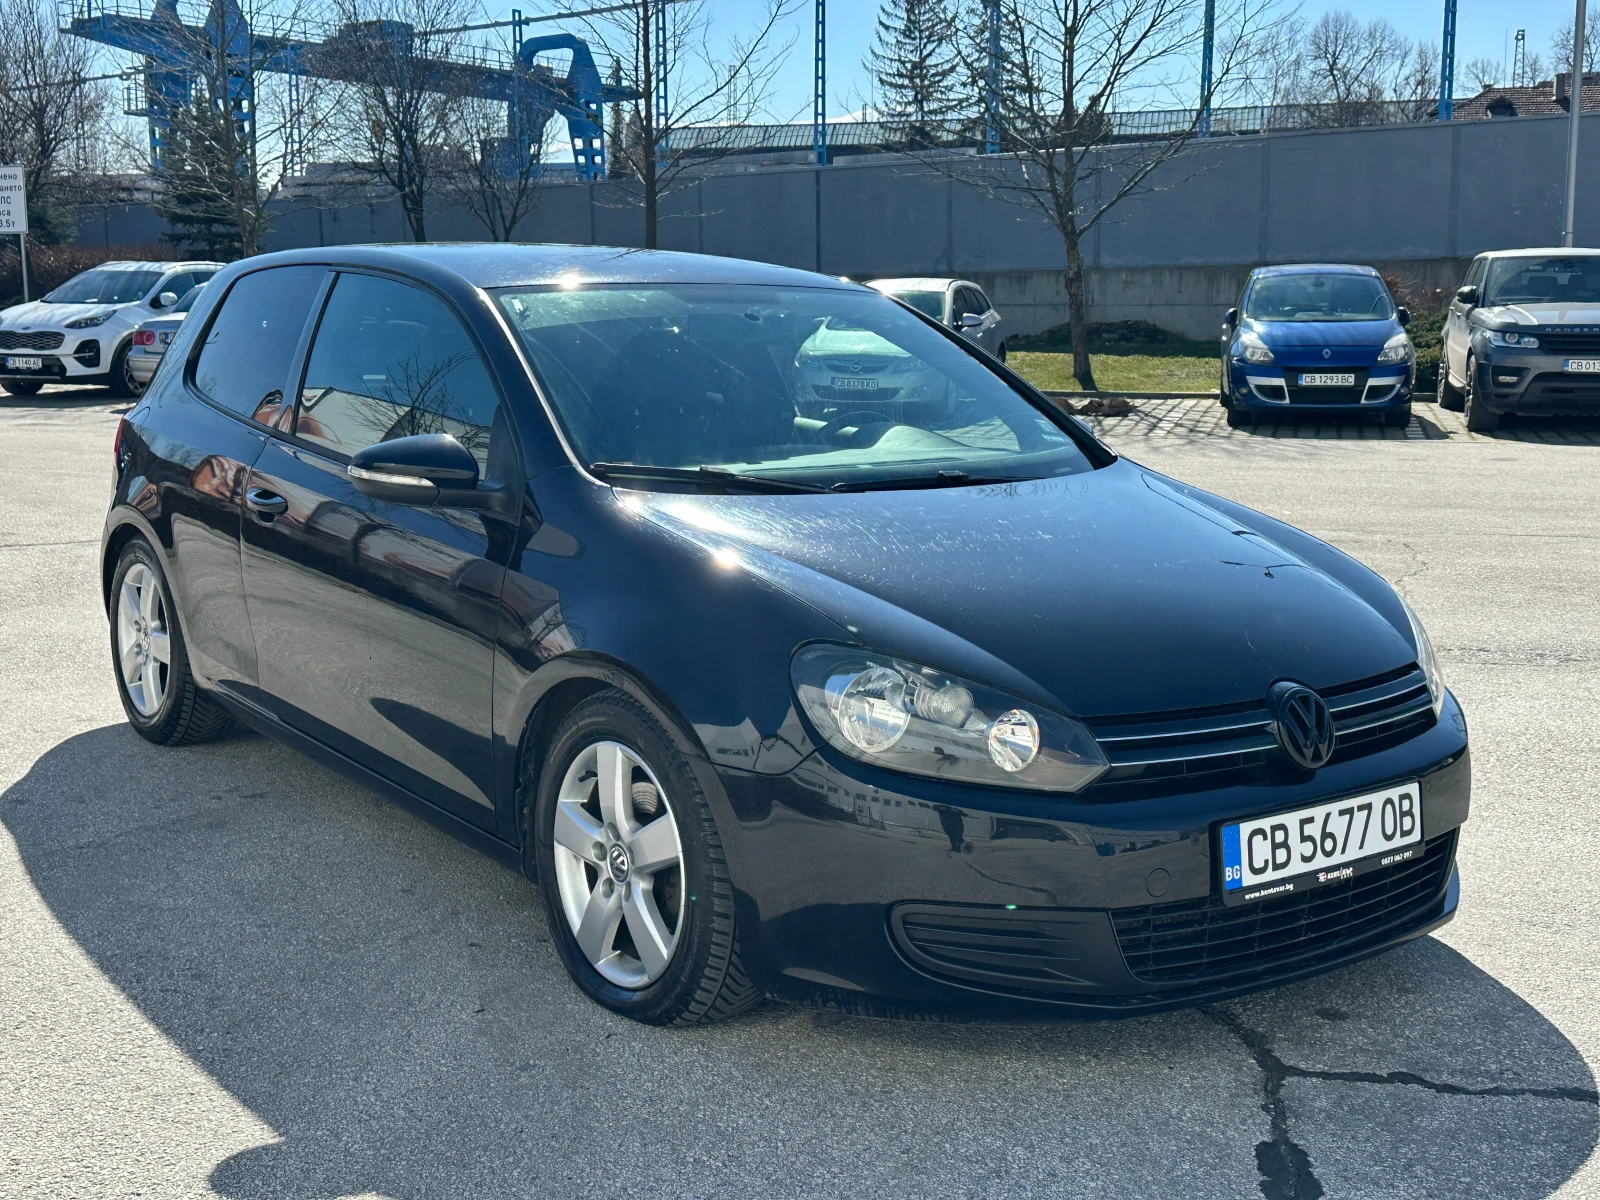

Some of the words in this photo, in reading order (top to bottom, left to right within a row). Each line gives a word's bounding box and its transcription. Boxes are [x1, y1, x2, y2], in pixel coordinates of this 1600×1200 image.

[1570, 361, 1583, 371] CB
[1304, 375, 1316, 384] CB
[1319, 375, 1340, 384] 1293
[1340, 375, 1353, 384] BC
[1247, 822, 1292, 876] CB
[1298, 801, 1373, 864] 5677
[1380, 792, 1416, 842] OB
[1225, 865, 1241, 881] BG
